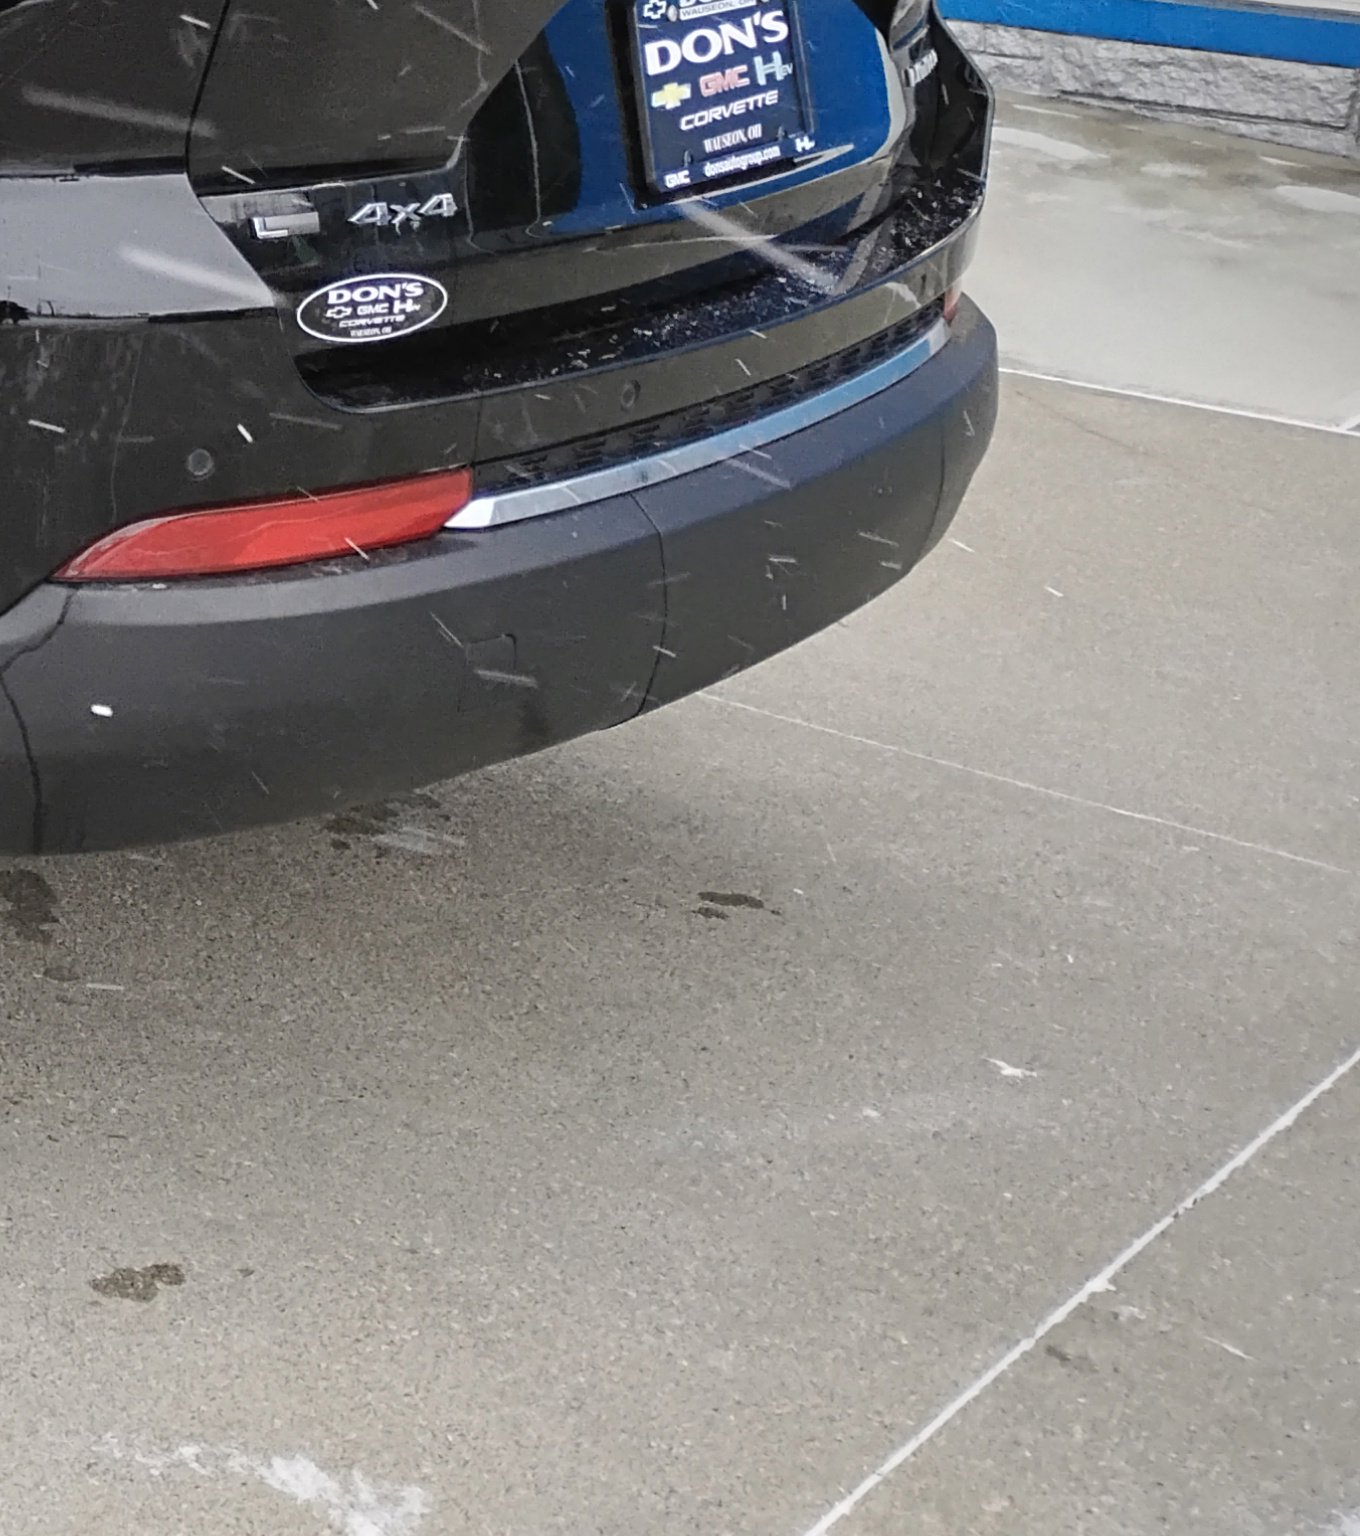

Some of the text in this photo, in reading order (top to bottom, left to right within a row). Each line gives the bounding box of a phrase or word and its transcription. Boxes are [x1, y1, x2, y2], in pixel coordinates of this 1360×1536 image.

[644, 10, 789, 76] DON'S
[699, 65, 751, 98] GMC
[680, 90, 779, 131] CORVETTE
[347, 193, 458, 226] 4x4
[327, 282, 424, 305] DON'S
[356, 303, 389, 315] GMC
[338, 314, 406, 328] CORVETTE
